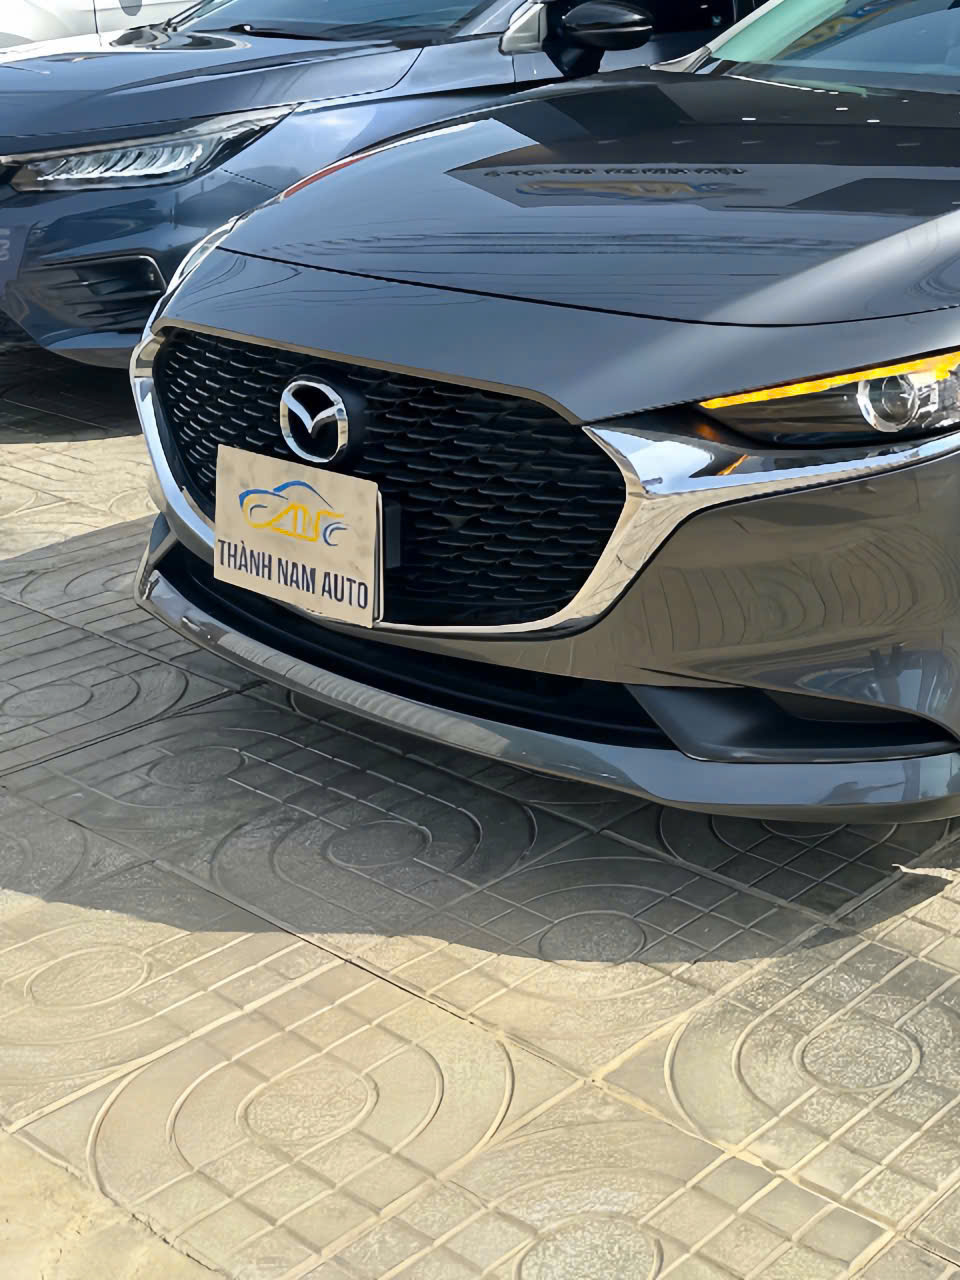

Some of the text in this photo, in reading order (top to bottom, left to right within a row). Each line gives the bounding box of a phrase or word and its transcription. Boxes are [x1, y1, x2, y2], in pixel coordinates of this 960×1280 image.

[217, 538, 369, 610] THÀNH NAM AUTO
